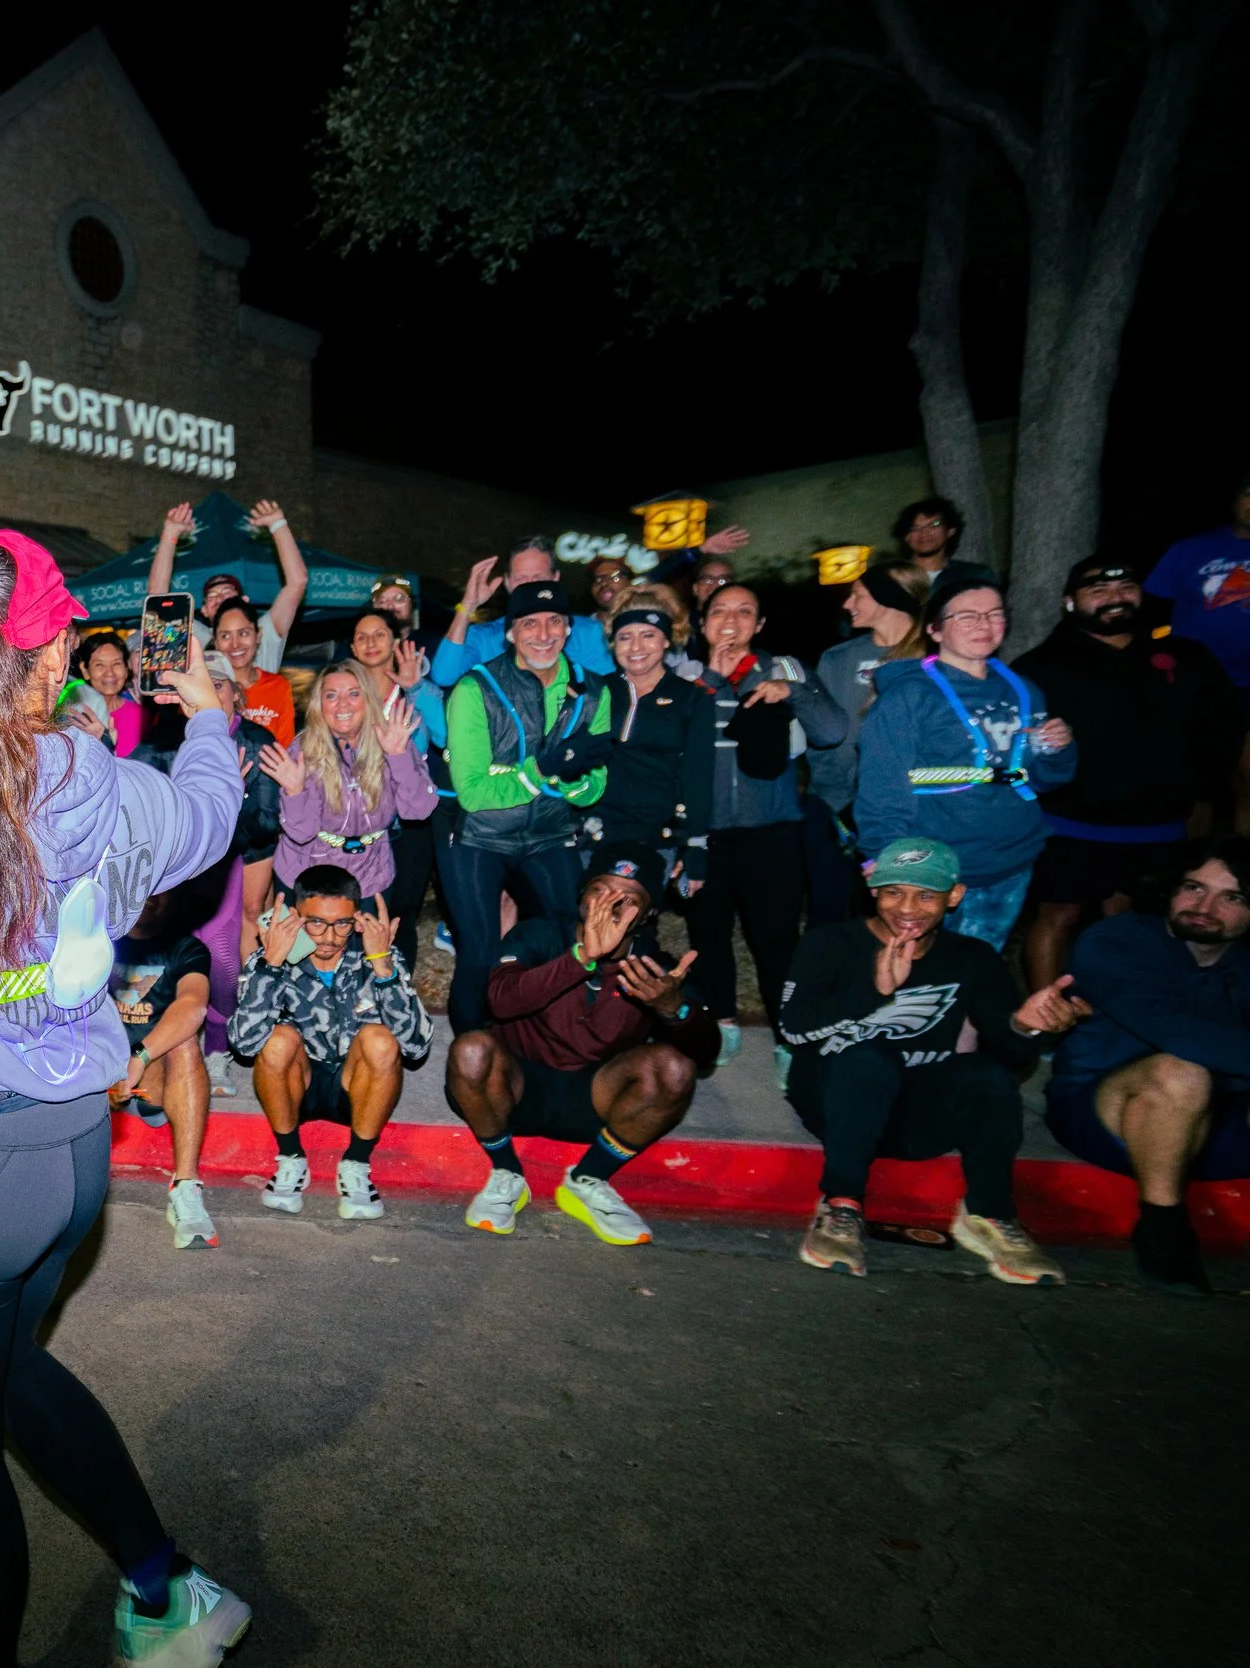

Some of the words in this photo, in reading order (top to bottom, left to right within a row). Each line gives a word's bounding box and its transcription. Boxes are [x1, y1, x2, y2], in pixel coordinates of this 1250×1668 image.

[30, 376, 124, 431] FORT
[123, 399, 235, 458] WORTH
[29, 420, 135, 460] RUNNING
[91, 583, 131, 601] SOCIAL
